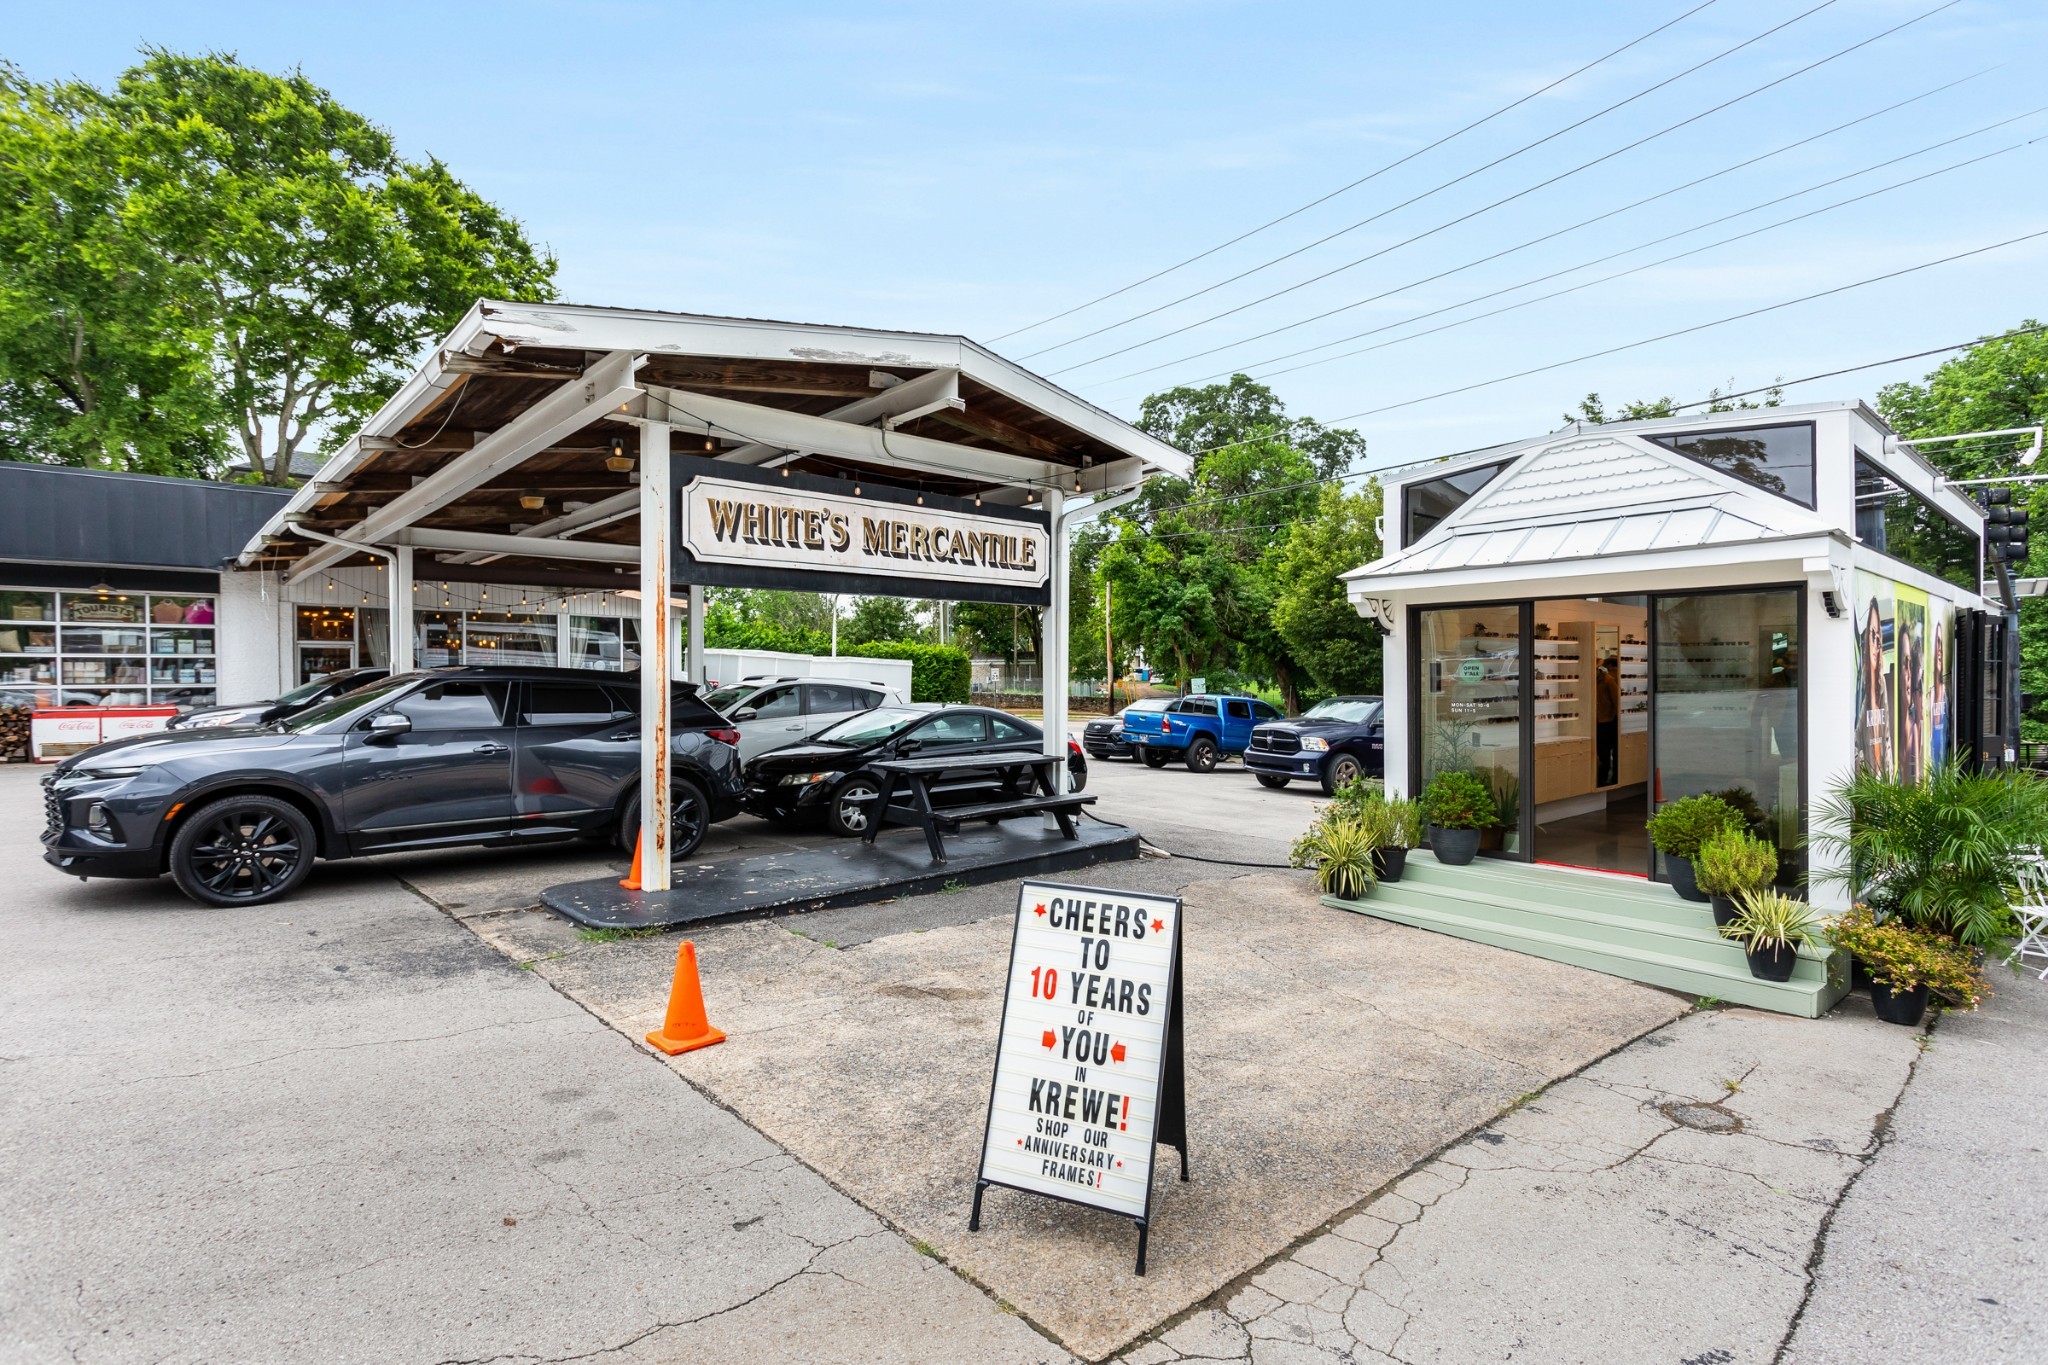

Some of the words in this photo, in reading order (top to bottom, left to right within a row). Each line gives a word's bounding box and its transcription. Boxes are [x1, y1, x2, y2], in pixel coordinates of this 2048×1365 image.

[706, 497, 850, 552] WHITE'S
[861, 515, 1037, 572] MERCANTILE
[74, 603, 136, 617] TOURISTS
[1049, 897, 1148, 940] CHEERS
[1080, 936, 1111, 971] TO
[1030, 965, 1058, 1000] 10
[1071, 971, 1152, 1016] YEARS
[1077, 1009, 1095, 1026] OF
[1061, 1025, 1110, 1066] YOU
[1074, 1065, 1087, 1083] IN
[1028, 1077, 1130, 1132] KREWE!
[1036, 1117, 1069, 1139] SHOP
[1083, 1128, 1109, 1149] OUR
[1024, 1135, 1115, 1170] ANNIVERSARY
[1041, 1159, 1102, 1189] FRAMES!
